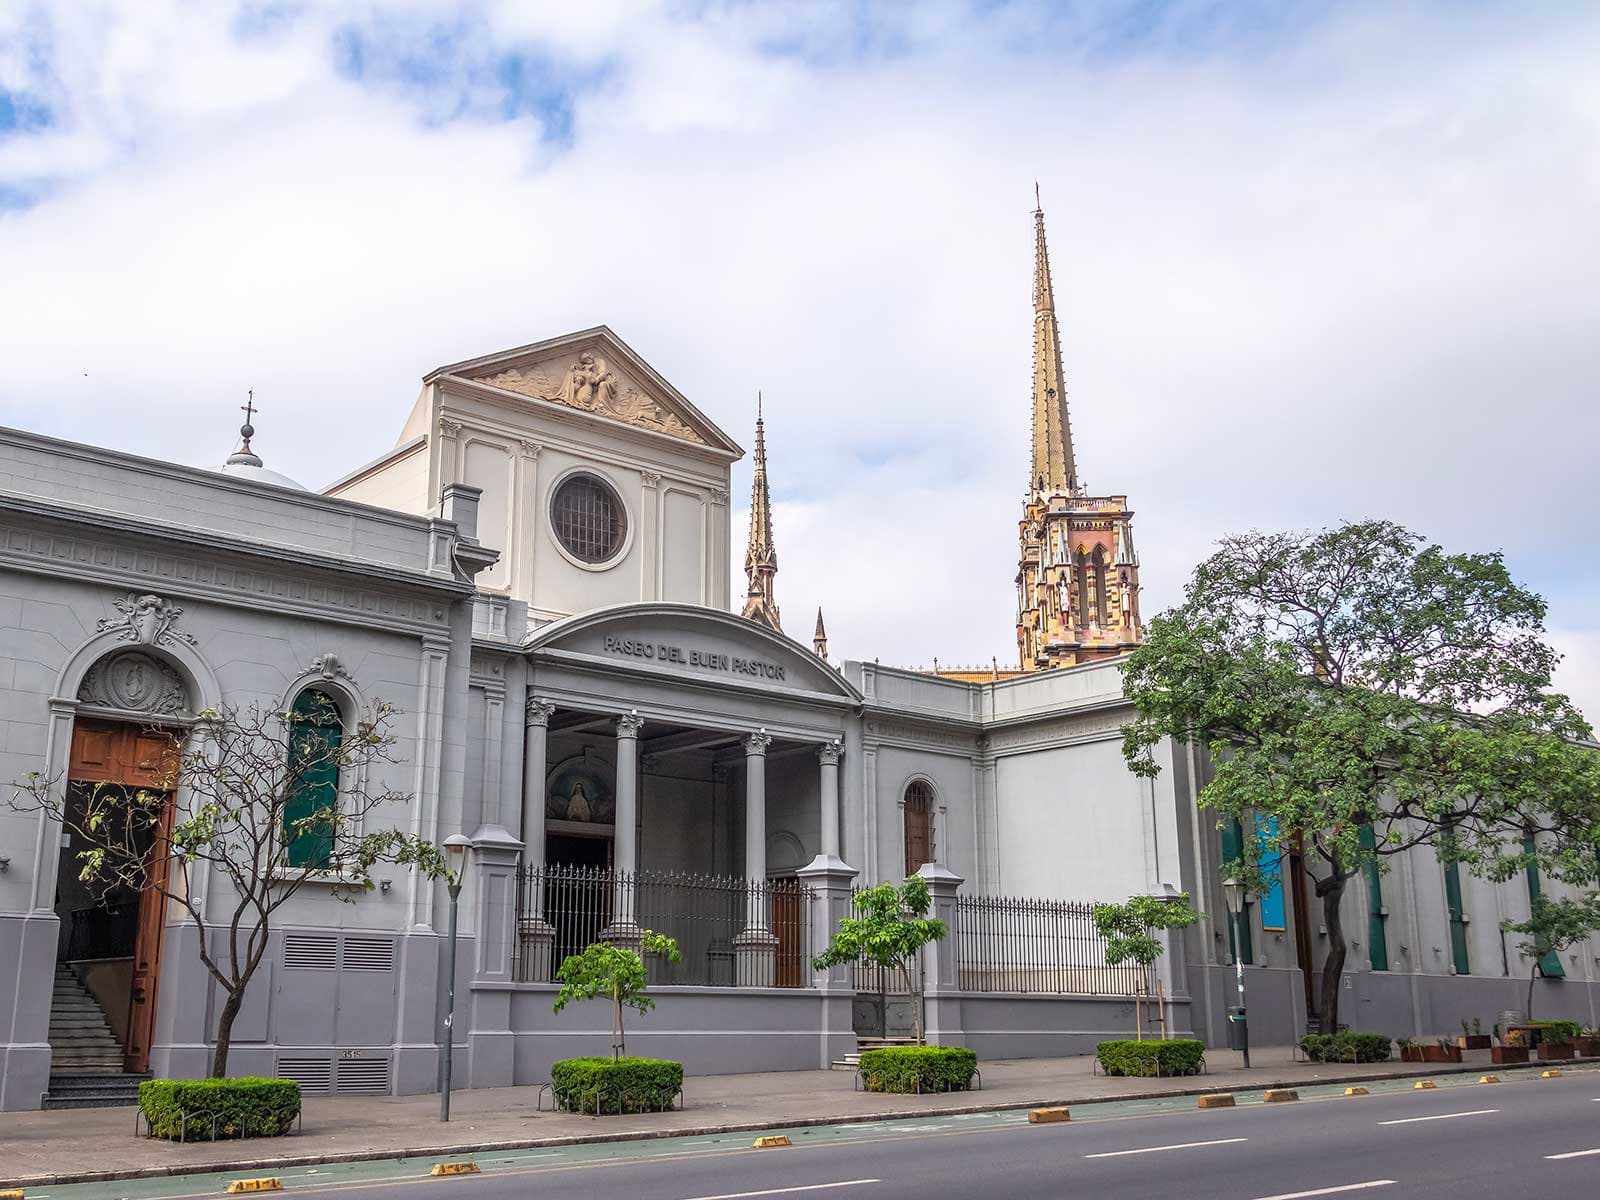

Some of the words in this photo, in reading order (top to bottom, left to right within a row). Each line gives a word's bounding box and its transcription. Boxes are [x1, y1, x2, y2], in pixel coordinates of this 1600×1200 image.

[604, 635, 655, 658] PASEO
[657, 645, 687, 664] DEL
[689, 651, 729, 671] BUEN
[732, 658, 786, 681] PASTOR
